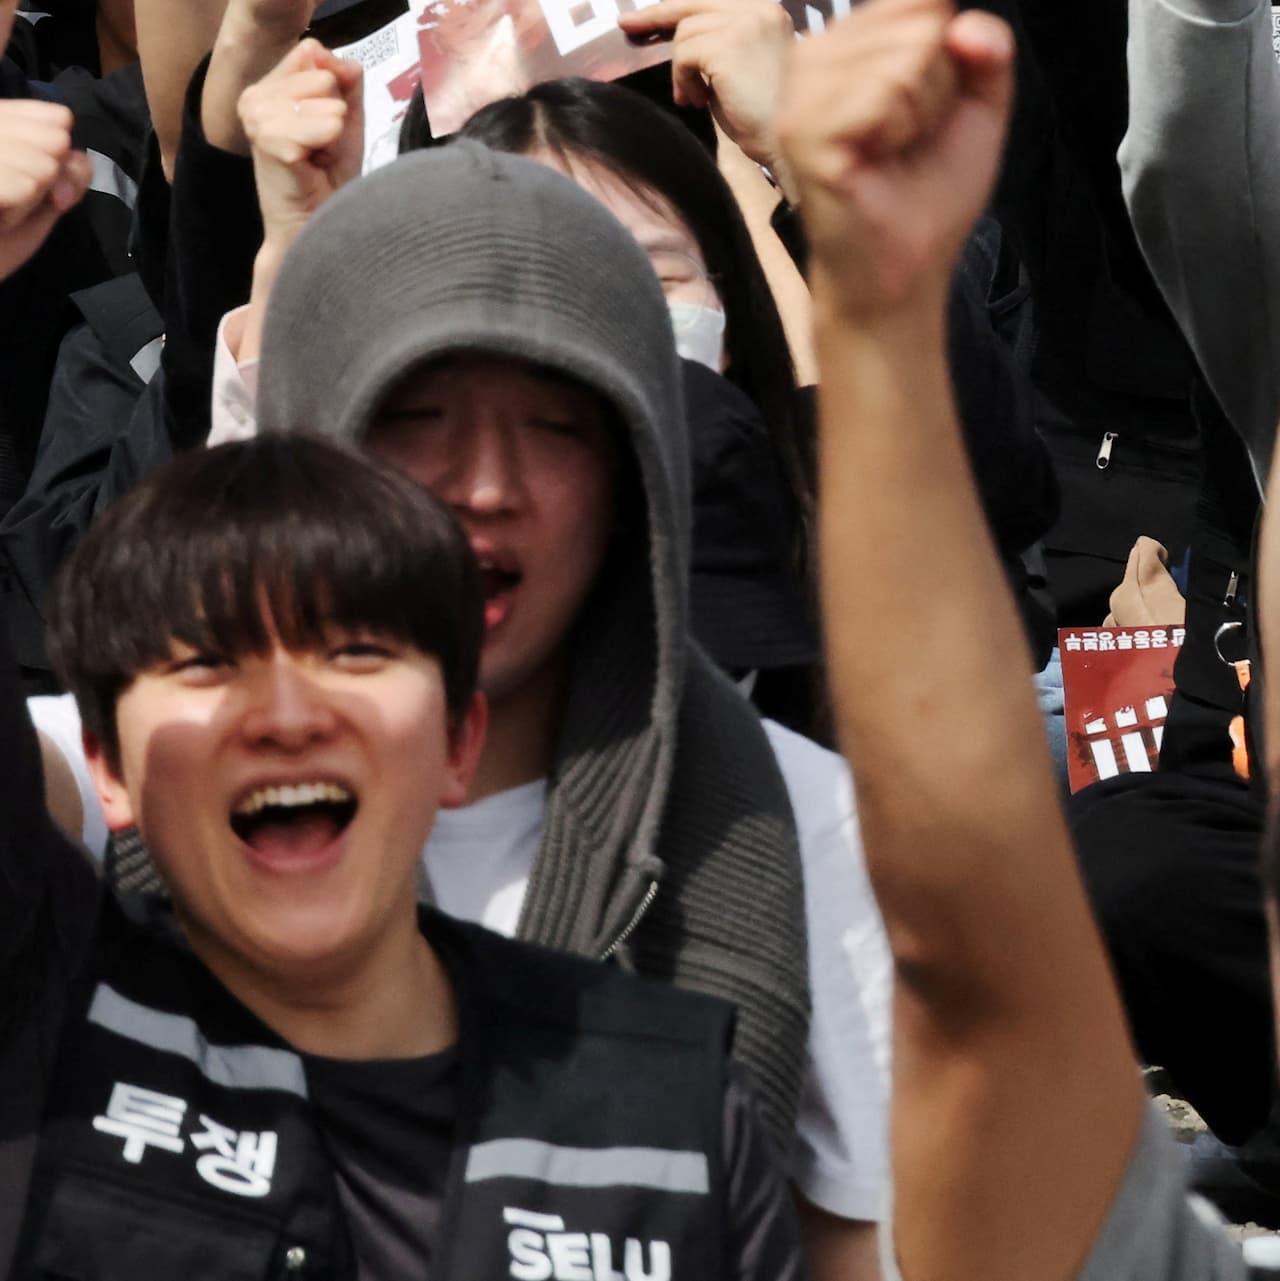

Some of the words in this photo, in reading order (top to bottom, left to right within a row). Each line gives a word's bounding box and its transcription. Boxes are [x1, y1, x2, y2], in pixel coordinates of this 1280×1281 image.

[1064, 629, 1168, 652] 공동투쟁본부
[92, 1081, 278, 1198] 투쟁
[503, 1206, 672, 1281] SELU
